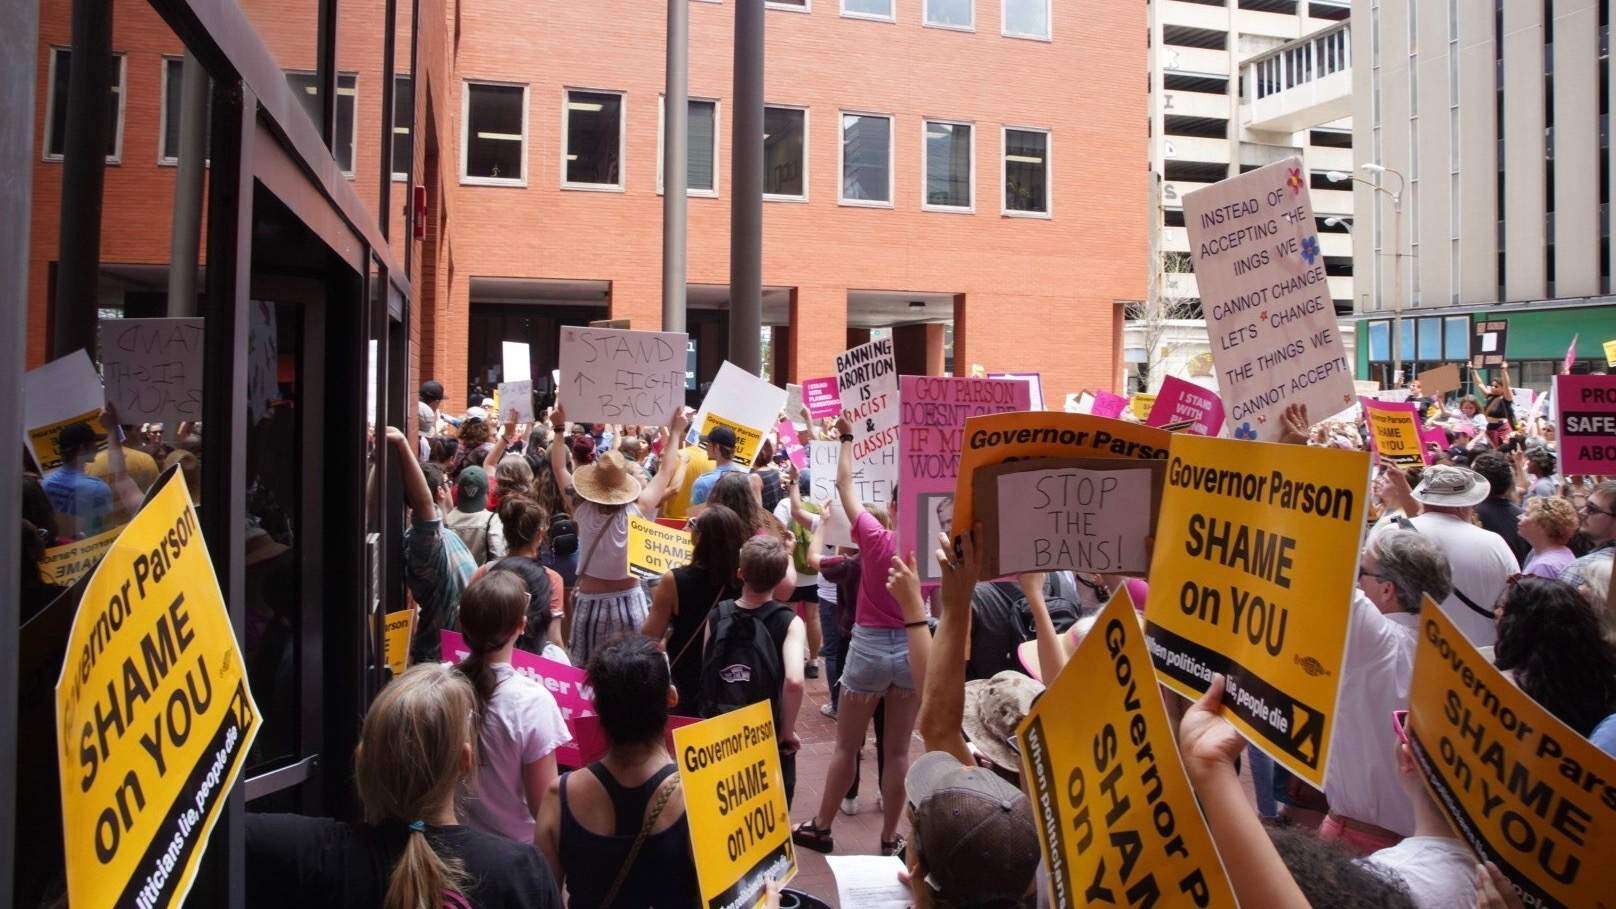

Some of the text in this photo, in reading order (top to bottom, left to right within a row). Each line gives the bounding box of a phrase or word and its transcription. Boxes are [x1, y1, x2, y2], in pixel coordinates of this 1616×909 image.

[1201, 188, 1284, 229] INSTEAD OF
[1200, 220, 1277, 259] ACCEPTING
[1276, 238, 1298, 258] WE
[1213, 288, 1268, 320] CANNOT
[1220, 295, 1325, 350] LET'S CHANGE
[581, 333, 674, 363] STAND
[837, 340, 892, 373] BANNING
[1226, 328, 1333, 385] THE THINGS WE
[840, 357, 894, 391] ABORTION
[860, 384, 871, 401] IS
[915, 378, 1015, 404] GOV PARSON
[1232, 357, 1347, 421] CANNOT ACCEPT!
[1581, 388, 1616, 404] PRO
[853, 425, 900, 460] CLASSIST
[866, 418, 875, 432] &
[909, 427, 929, 452] IF
[970, 428, 1088, 450] Governor
[1034, 474, 1118, 509] STOP
[1169, 456, 1354, 521] Governor Parson
[631, 520, 675, 540] Governor
[1048, 511, 1097, 537] THE
[133, 504, 197, 600] Parson
[644, 538, 693, 561] SHAME
[645, 555, 662, 567] on
[1034, 536, 1122, 570] BANS!
[1185, 513, 1297, 589] SHAME
[1180, 581, 1288, 657] on YOU
[80, 591, 195, 793] SHAME
[1225, 674, 1238, 701] lie,
[1236, 684, 1268, 721] people
[1268, 703, 1288, 733] die
[1424, 618, 1534, 742] Governor
[95, 654, 213, 864] on YOU
[684, 719, 773, 773] Governor Parson
[1028, 727, 1048, 791] When
[1106, 618, 1189, 859] Governor
[178, 809, 200, 837] lie,
[195, 748, 228, 814] people
[224, 725, 238, 751] die
[716, 760, 769, 816] SHAME
[1443, 688, 1595, 848] SHAME
[728, 800, 776, 862] on YOU
[1068, 766, 1094, 855] on
[1439, 735, 1473, 794] on
[1479, 777, 1582, 887] YOU
